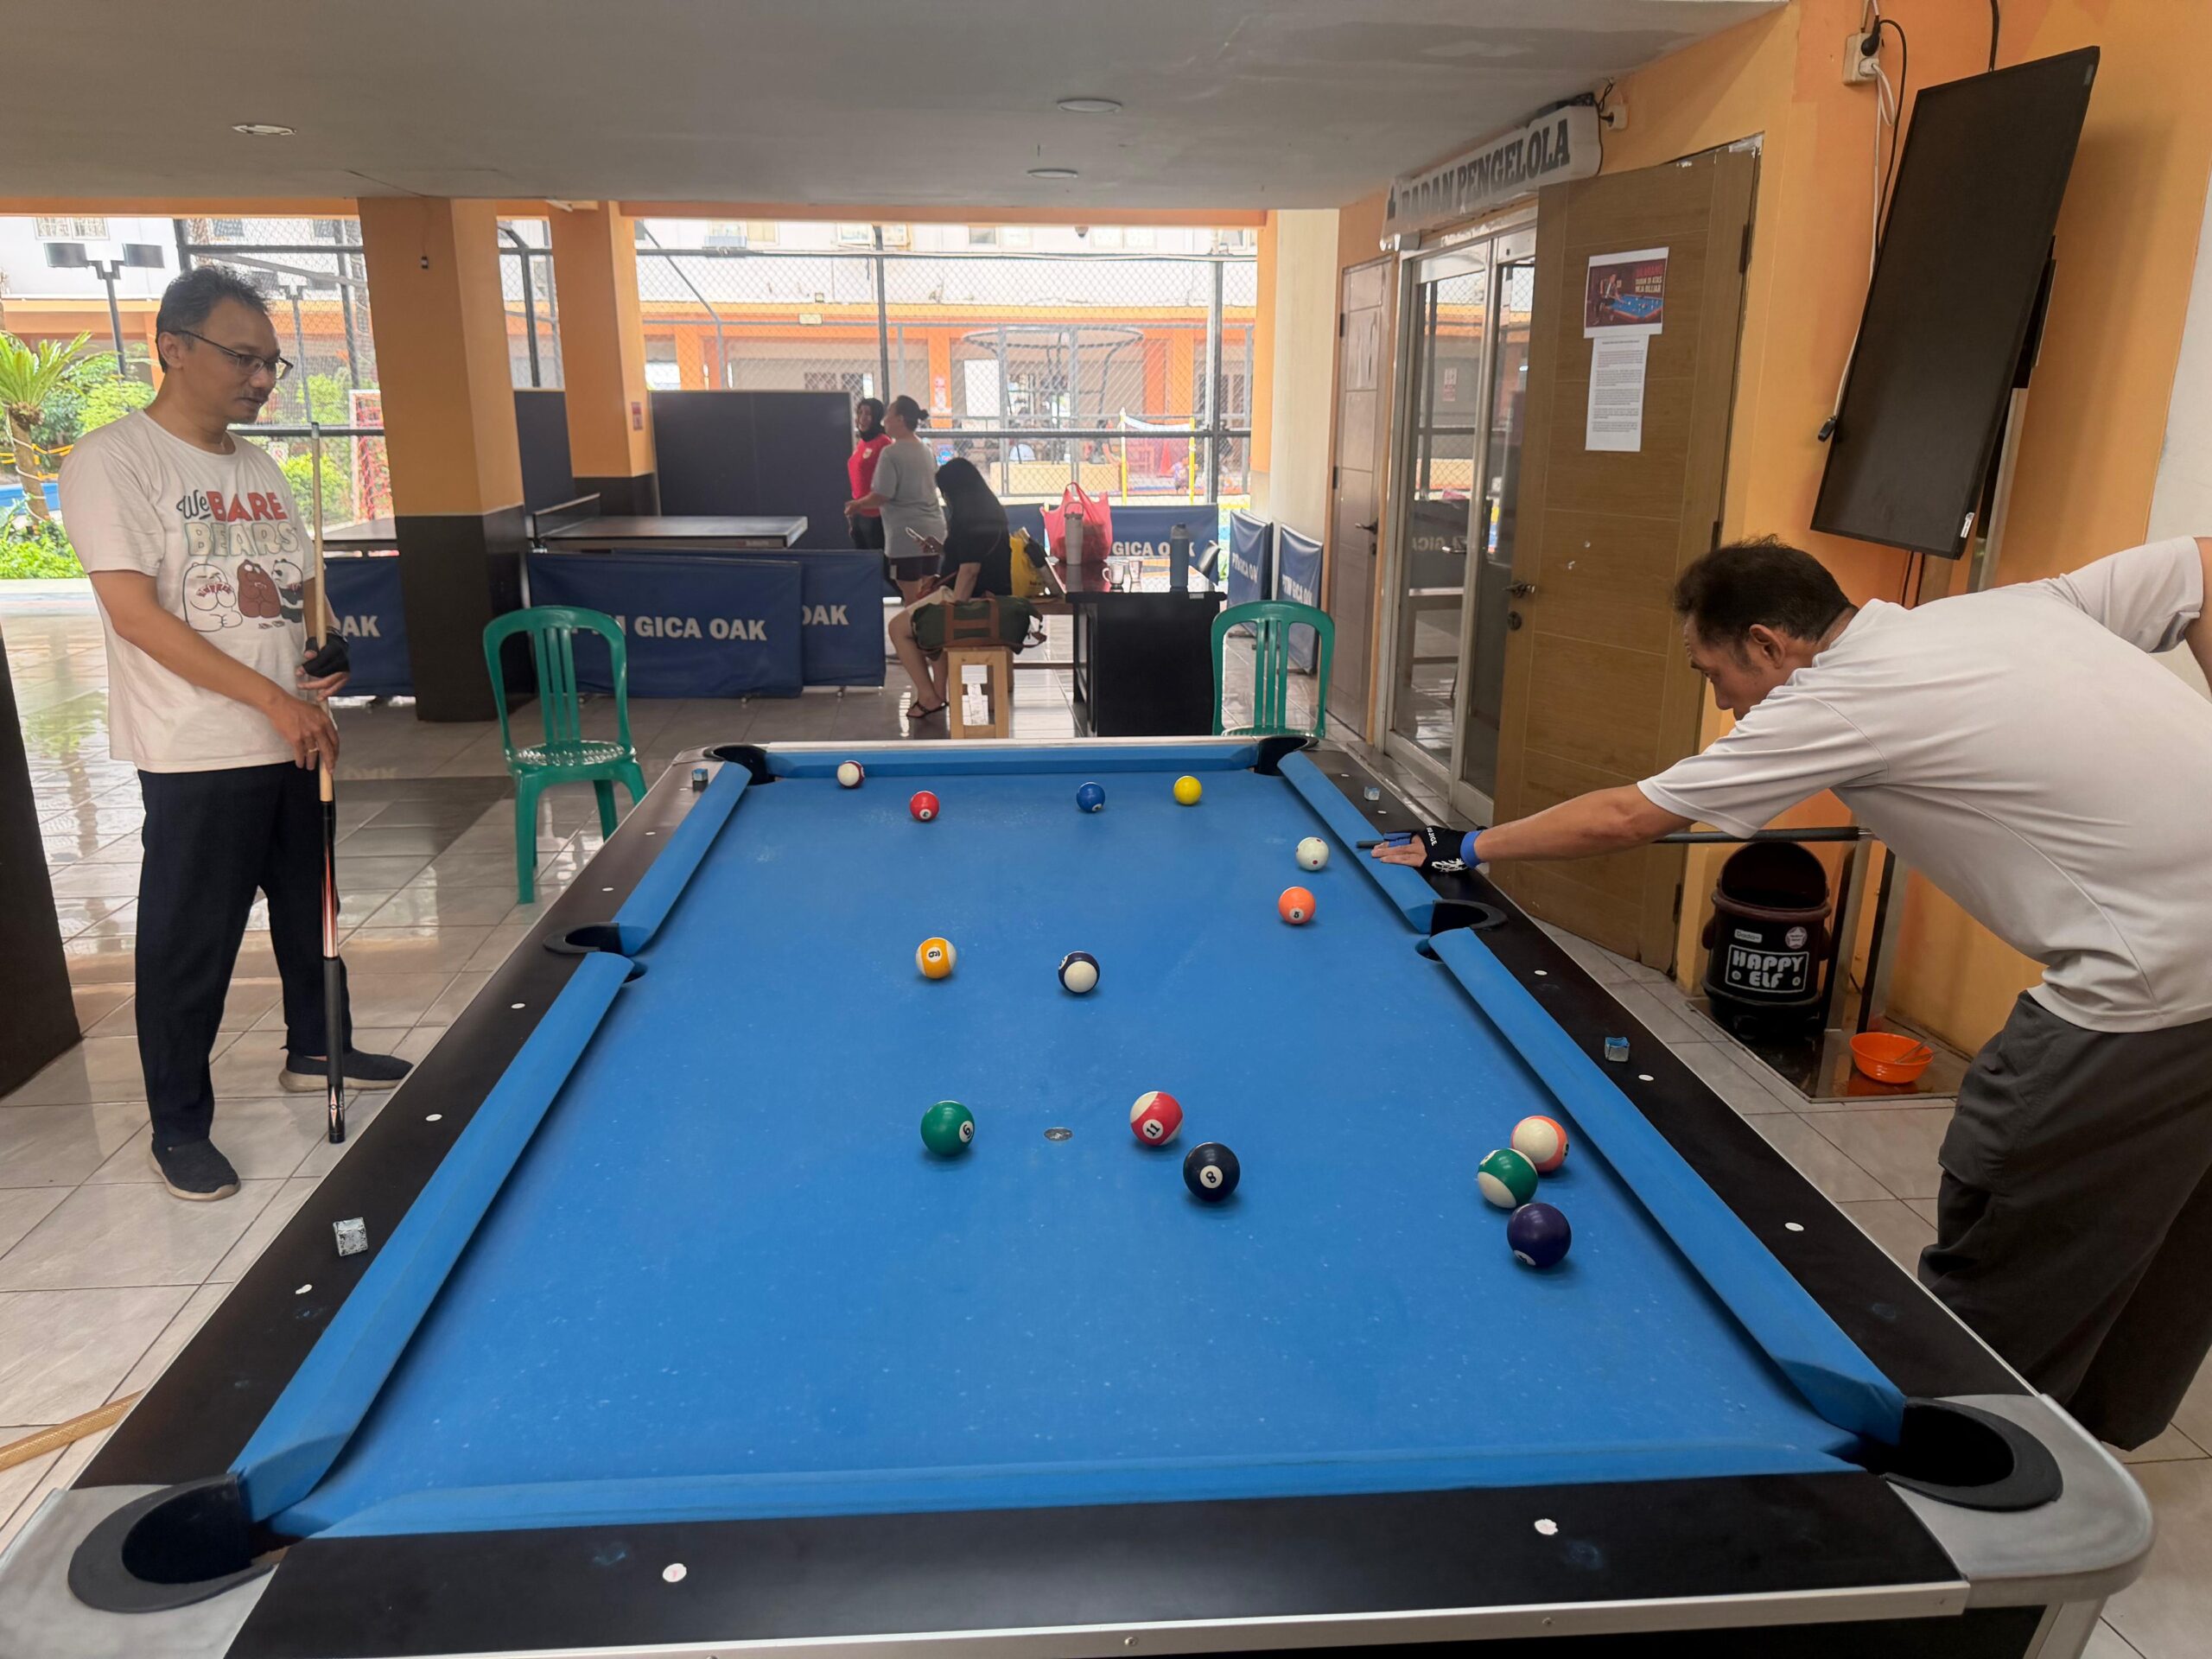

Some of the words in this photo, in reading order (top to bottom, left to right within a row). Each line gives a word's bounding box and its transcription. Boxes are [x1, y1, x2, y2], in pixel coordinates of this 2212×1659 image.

[1455, 118, 1570, 210] PENGELOLA
[176, 490, 211, 519] We
[206, 491, 288, 522] BARE
[184, 521, 299, 556] BEARS
[1112, 542, 1154, 558] GICA
[1158, 542, 1196, 557] OK
[342, 615, 381, 638] AK
[633, 616, 702, 639] GICA
[709, 618, 767, 641] OAK
[1732, 950, 1805, 972] HAPPY
[1749, 970, 1783, 988] ELF
[963, 1124, 972, 1139] 6
[1146, 1122, 1160, 1137] 11
[1205, 1171, 1217, 1184] 8
